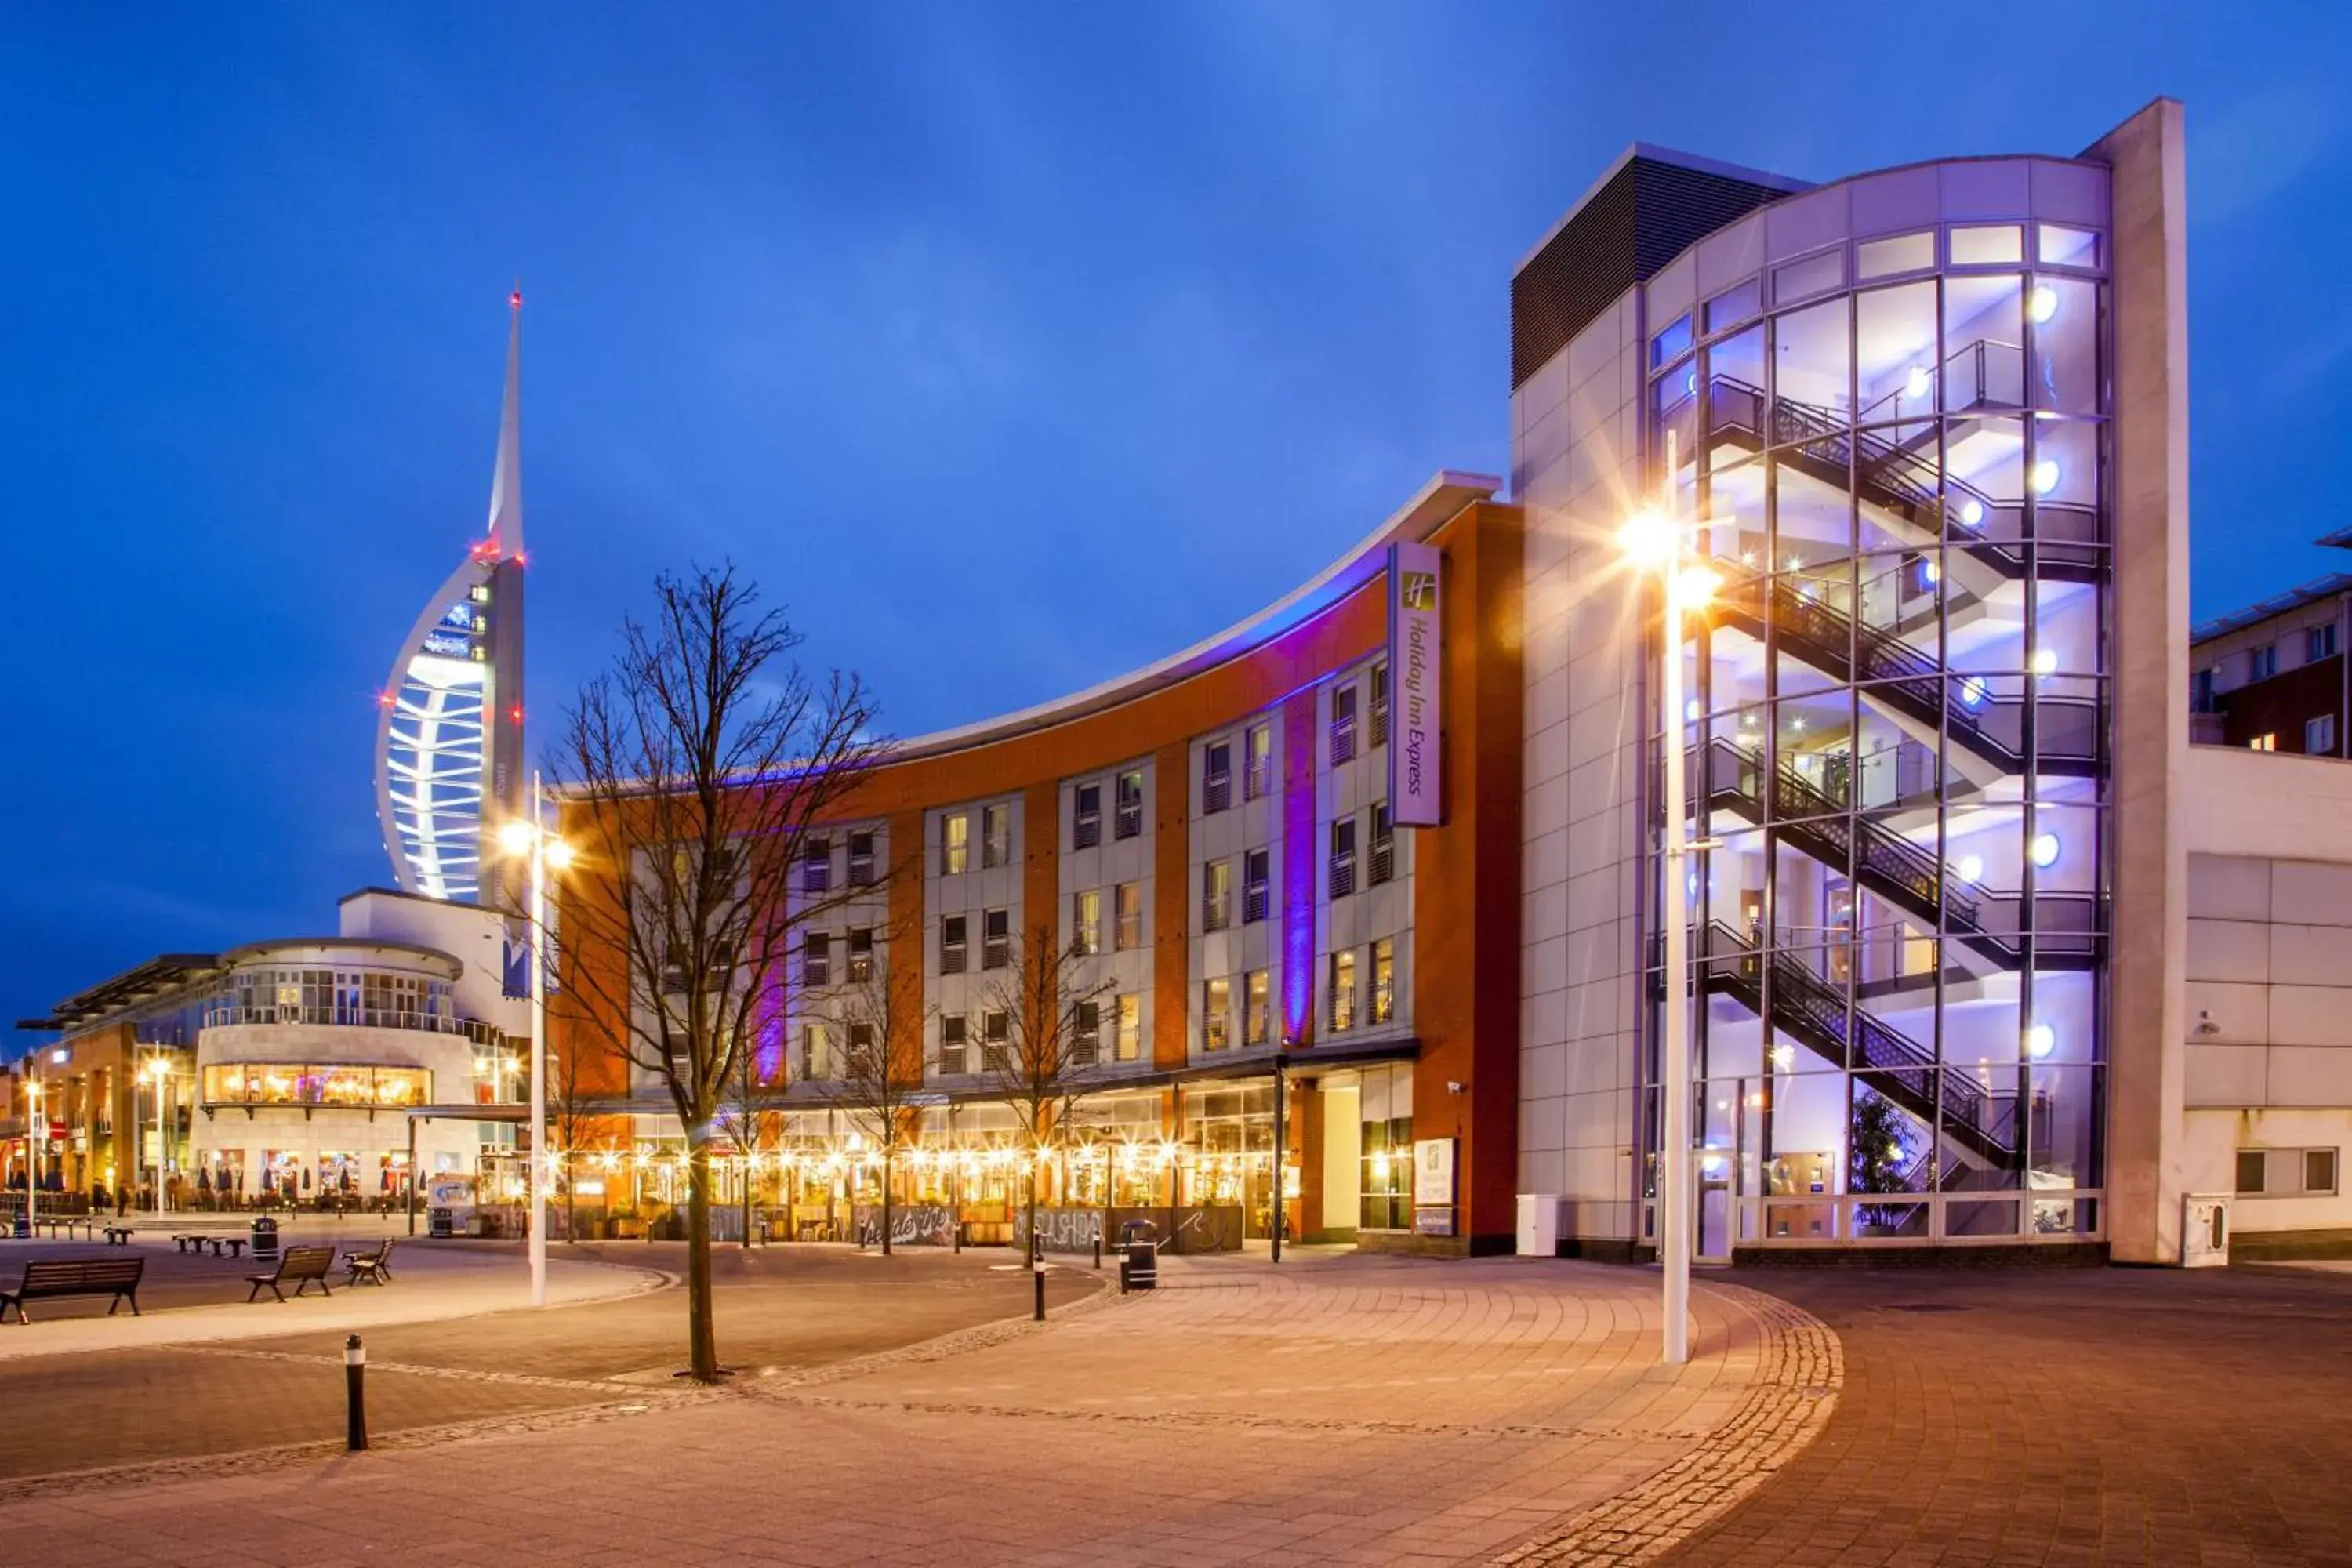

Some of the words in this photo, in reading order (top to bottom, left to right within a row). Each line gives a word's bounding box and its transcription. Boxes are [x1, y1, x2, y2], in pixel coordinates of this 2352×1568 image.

[1406, 616, 1428, 691] Holiday
[1410, 695, 1427, 725] Inn
[1406, 728, 1425, 796] Express
